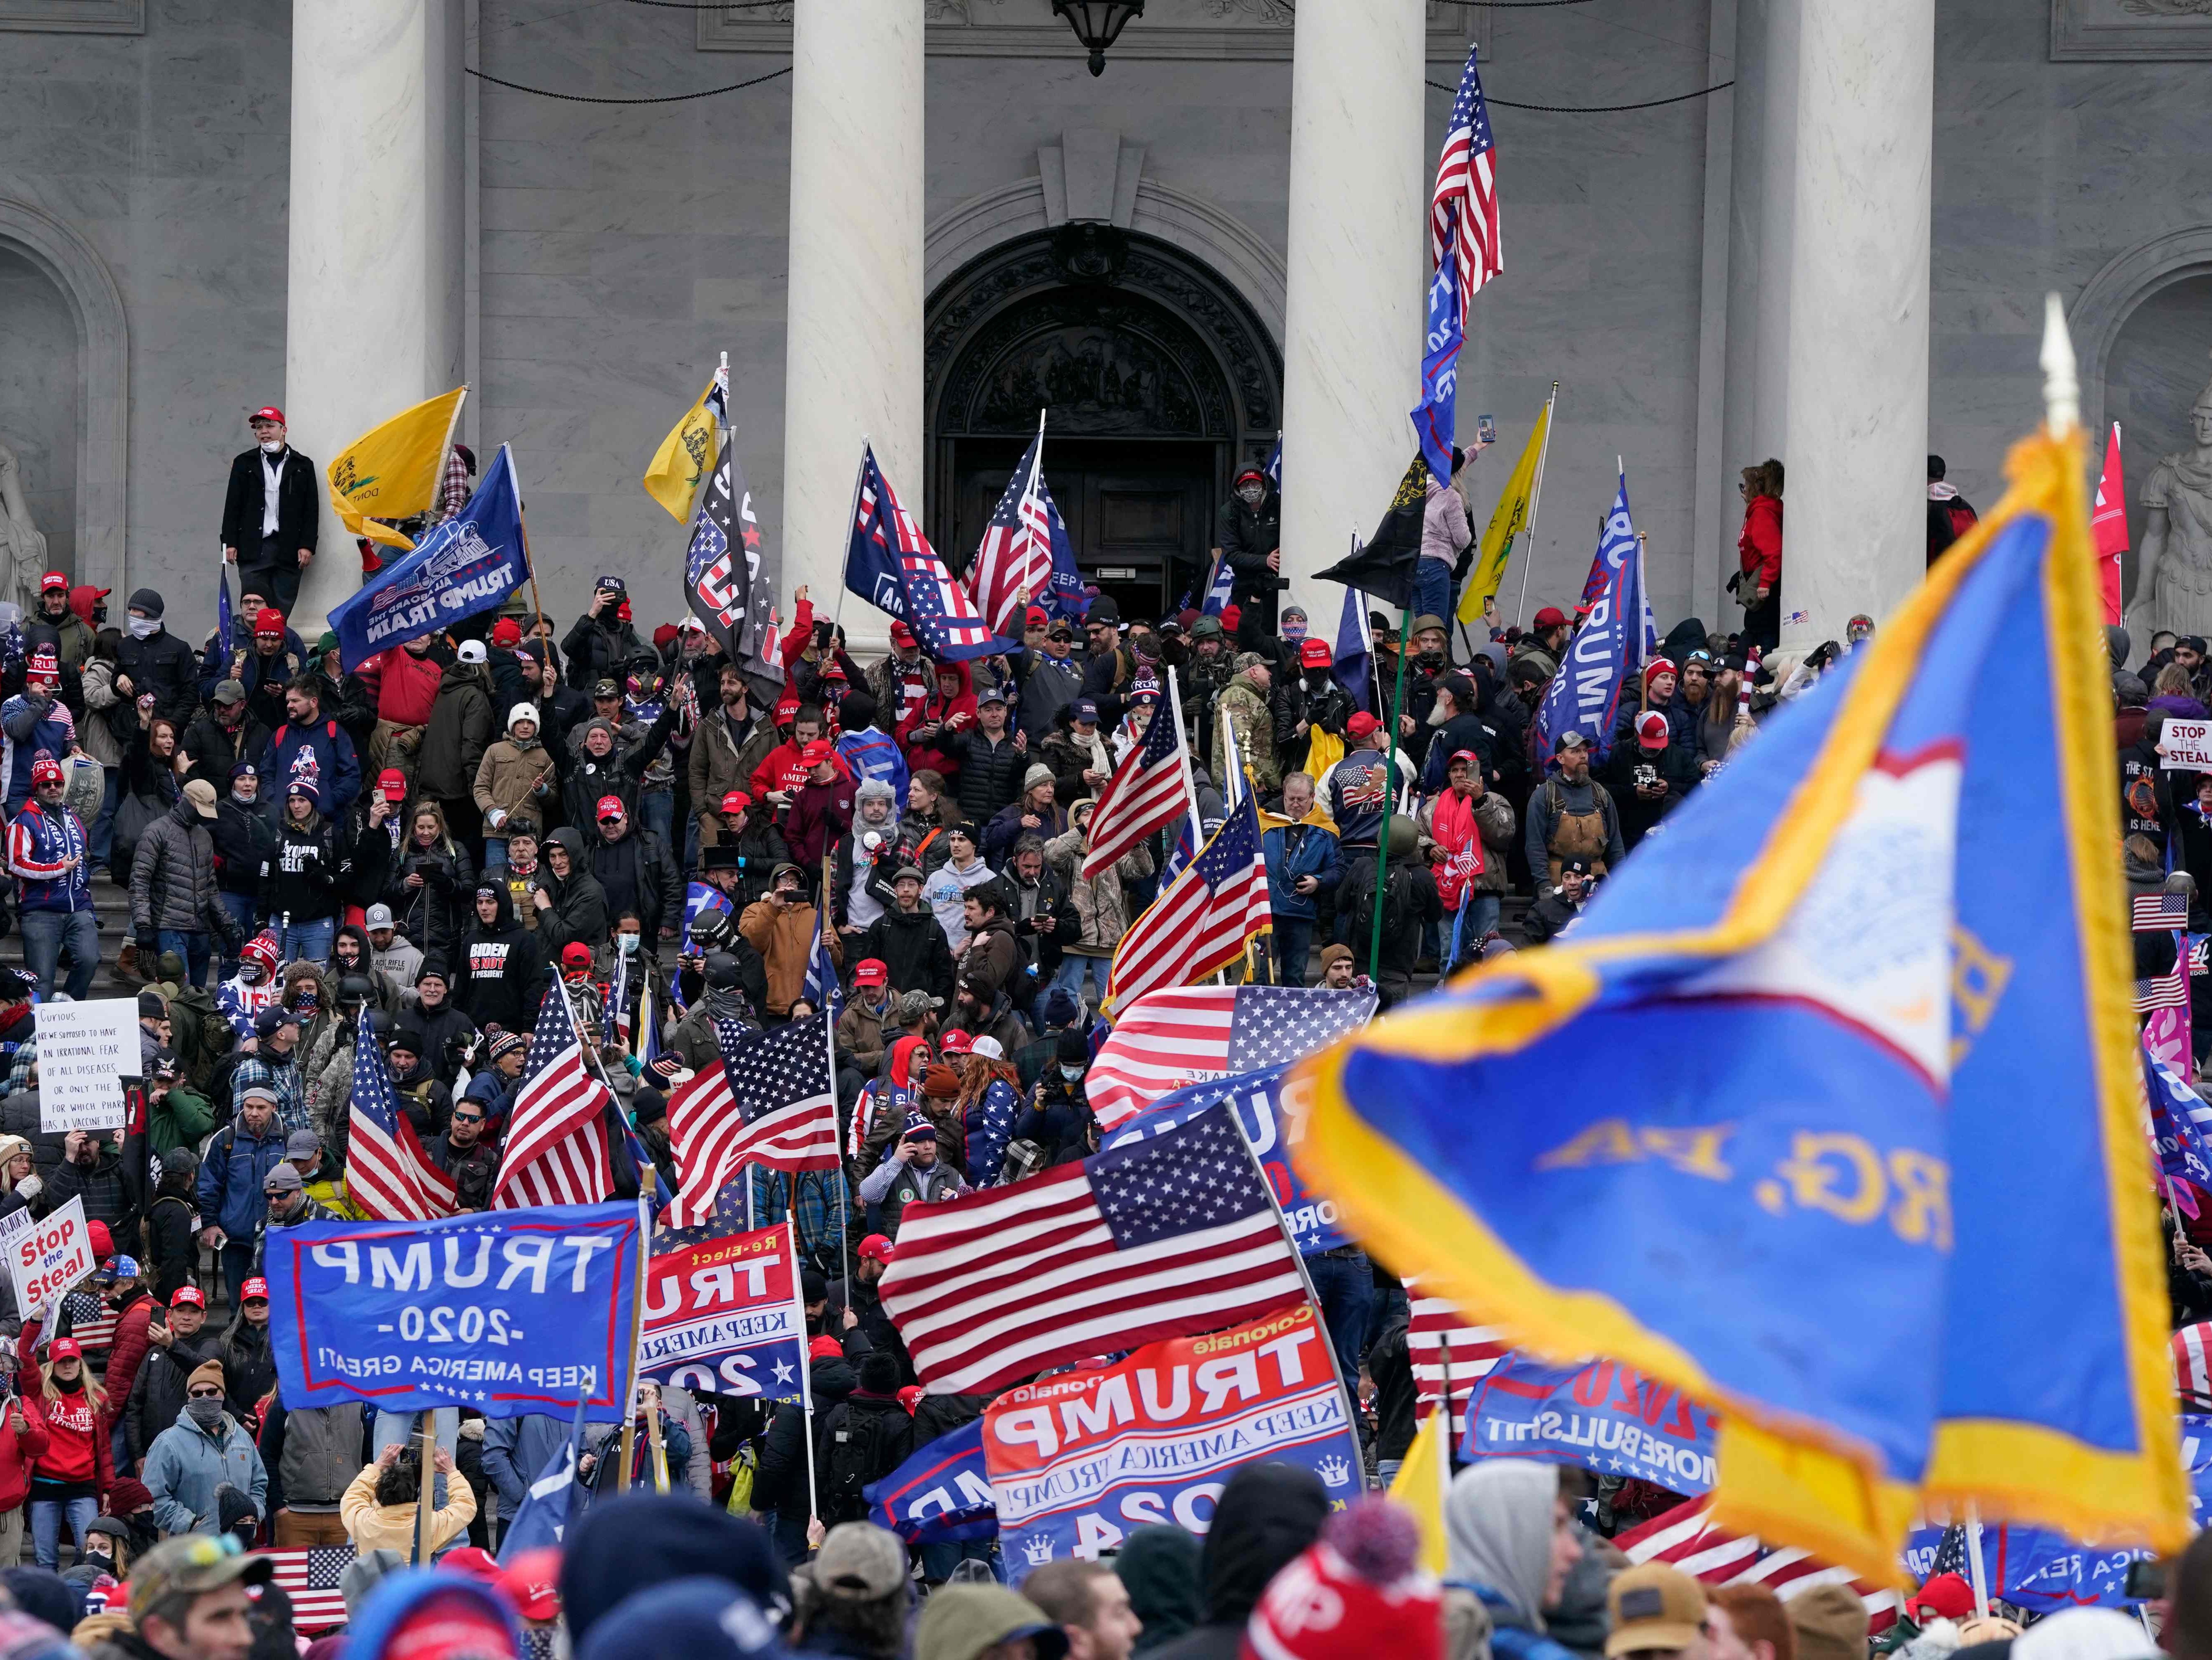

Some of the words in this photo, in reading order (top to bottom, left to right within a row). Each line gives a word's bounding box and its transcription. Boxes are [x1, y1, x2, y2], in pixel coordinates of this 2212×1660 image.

[605, 579, 620, 589] USA
[1052, 572, 1076, 587] EEP
[2172, 726, 2206, 739] STOP
[2178, 739, 2200, 750] THE
[2170, 750, 2212, 764] STEAL
[2126, 763, 2140, 775] THE
[2131, 819, 2139, 830] IS
[2140, 820, 2161, 832] HERE
[933, 892, 943, 900] OUT
[944, 892, 951, 900] OF
[951, 892, 965, 901] SHA
[717, 925, 729, 939] PRESS
[469, 943, 510, 958] BIDEN
[370, 959, 387, 967] LACK
[470, 958, 479, 969] IS
[481, 957, 506, 969] NOT
[37, 1032, 47, 1040] ARE
[59, 1030, 86, 1039] SUPPOSED
[100, 1028, 117, 1037] HAVE
[502, 1038, 523, 1050] GREAT
[44, 1049, 53, 1058] AN
[57, 1046, 96, 1057] IRRATIONAL
[100, 1044, 119, 1056] FEAR
[47, 1067, 56, 1077] OF
[61, 1067, 73, 1076] ALL
[77, 1063, 118, 1075] DISEASES,
[54, 1086, 64, 1095] OR
[69, 1085, 89, 1093] ONLY
[94, 1084, 111, 1092] THE
[52, 1104, 66, 1113] FOR
[70, 1103, 95, 1112] WHICH
[42, 1120, 57, 1131] HAS
[63, 1119, 68, 1129] A
[71, 1116, 101, 1128] VACCINE
[104, 1116, 112, 1125] TO
[21, 1218, 75, 1268] Stop
[43, 1249, 63, 1269] the
[26, 1247, 84, 1305] Steal
[245, 1283, 266, 1292] AMERICA
